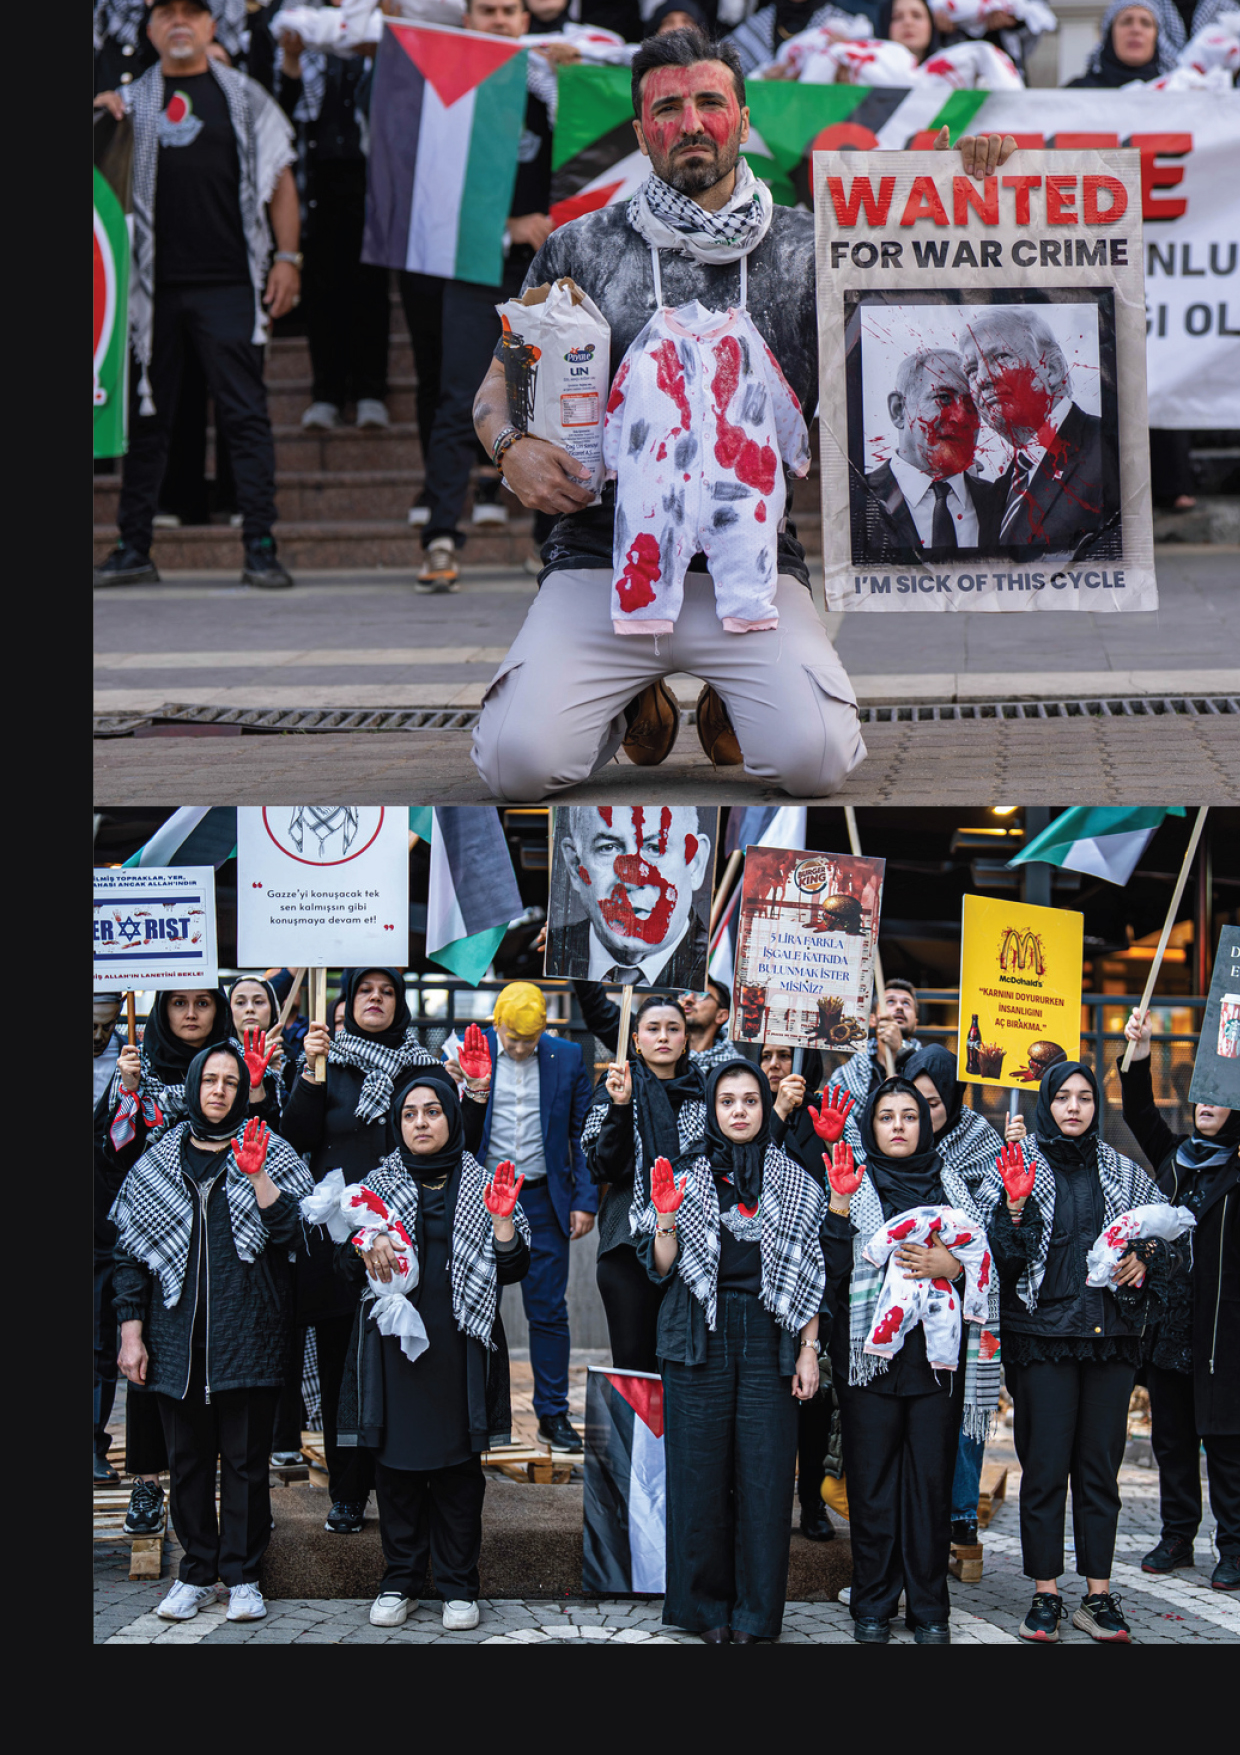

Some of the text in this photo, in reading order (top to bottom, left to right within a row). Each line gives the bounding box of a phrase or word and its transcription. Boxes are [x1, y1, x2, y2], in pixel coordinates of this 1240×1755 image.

[826, 174, 1129, 227] WANTED
[831, 238, 1129, 269] FOR WAR CRIME
[570, 367, 589, 376] UN
[855, 571, 1126, 594] I'M SICK OF THIS CYCLE
[797, 866, 827, 879] BURGER
[799, 873, 827, 887] KING
[266, 888, 380, 900] Gazze'yi konuşacak tek
[299, 902, 346, 913] kalmışsın
[347, 902, 367, 913] gibi
[270, 915, 377, 926] konuşmaya devam et!
[144, 917, 190, 940] RIST
[770, 932, 844, 949] 5 LİRA FARKLA
[763, 946, 849, 965] İŞGALE KATKIDA
[758, 963, 850, 982] BULUNMAK İSTER
[780, 980, 824, 995] MİSİNİZ?
[999, 975, 1043, 988] McDonald's
[1015, 992, 1065, 1007] DOYURURKEN
[995, 1017, 1005, 1029] AÇ
